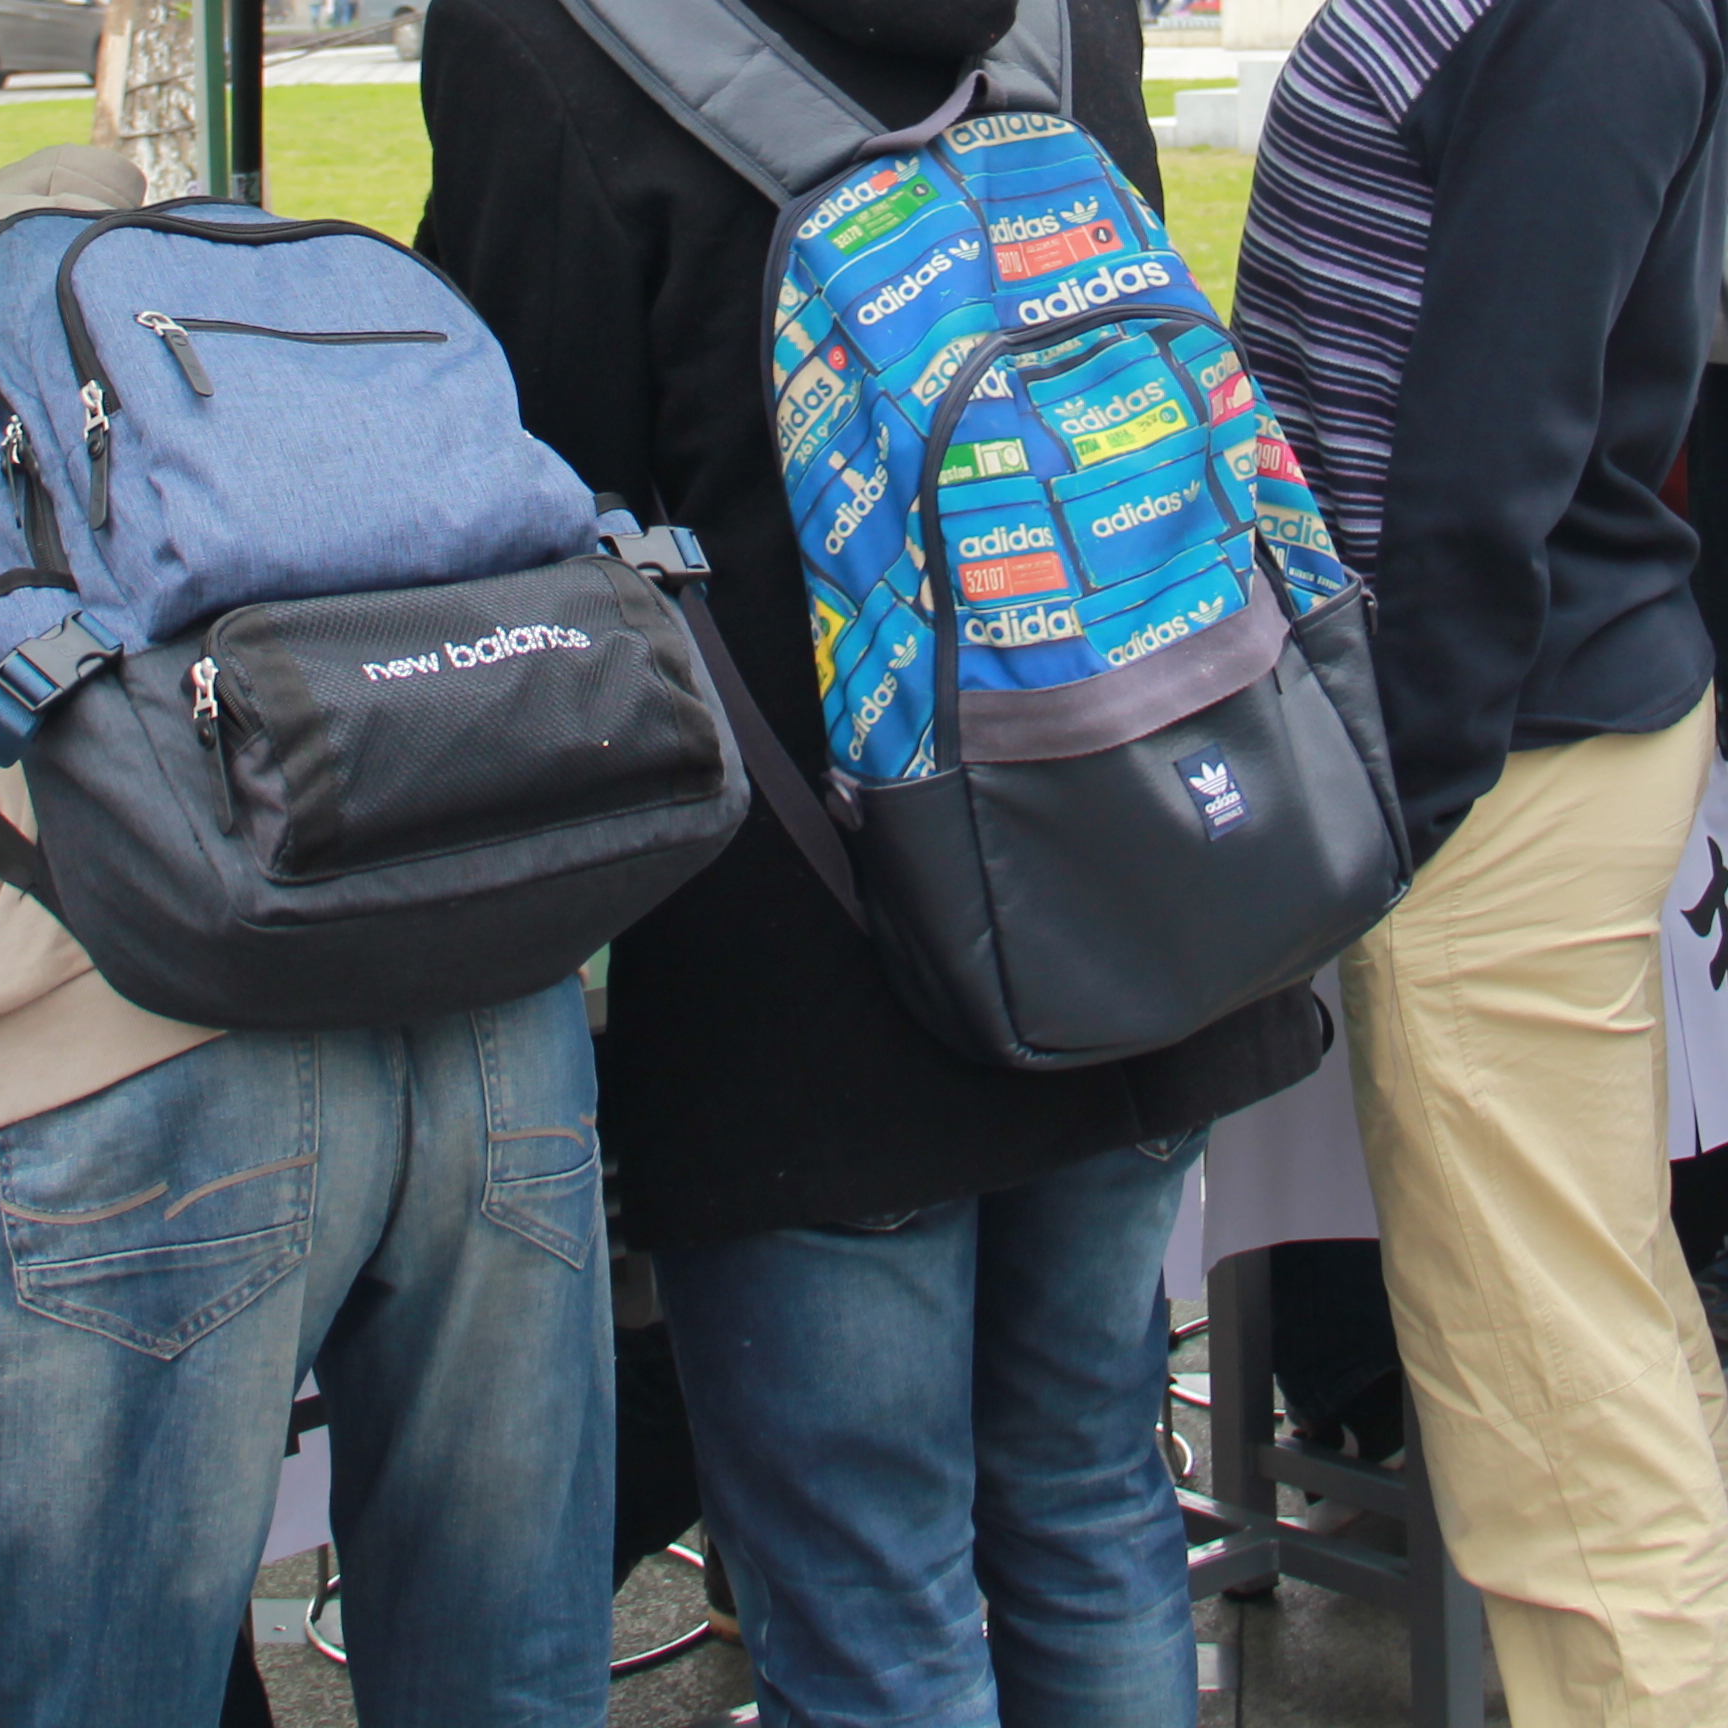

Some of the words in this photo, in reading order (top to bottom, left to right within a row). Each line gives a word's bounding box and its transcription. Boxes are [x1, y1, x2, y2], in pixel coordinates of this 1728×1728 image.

[857, 251, 954, 326] adidas
[1018, 261, 1171, 326] adidas
[1060, 380, 1166, 435] adidas
[824, 463, 889, 556] adidas
[1090, 490, 1183, 538] adidas
[958, 522, 1055, 559] adidas
[965, 565, 1006, 595] 52107
[362, 648, 441, 683] new
[443, 622, 592, 671] balance
[1107, 614, 1190, 667] adidas
[848, 671, 899, 762] adidas
